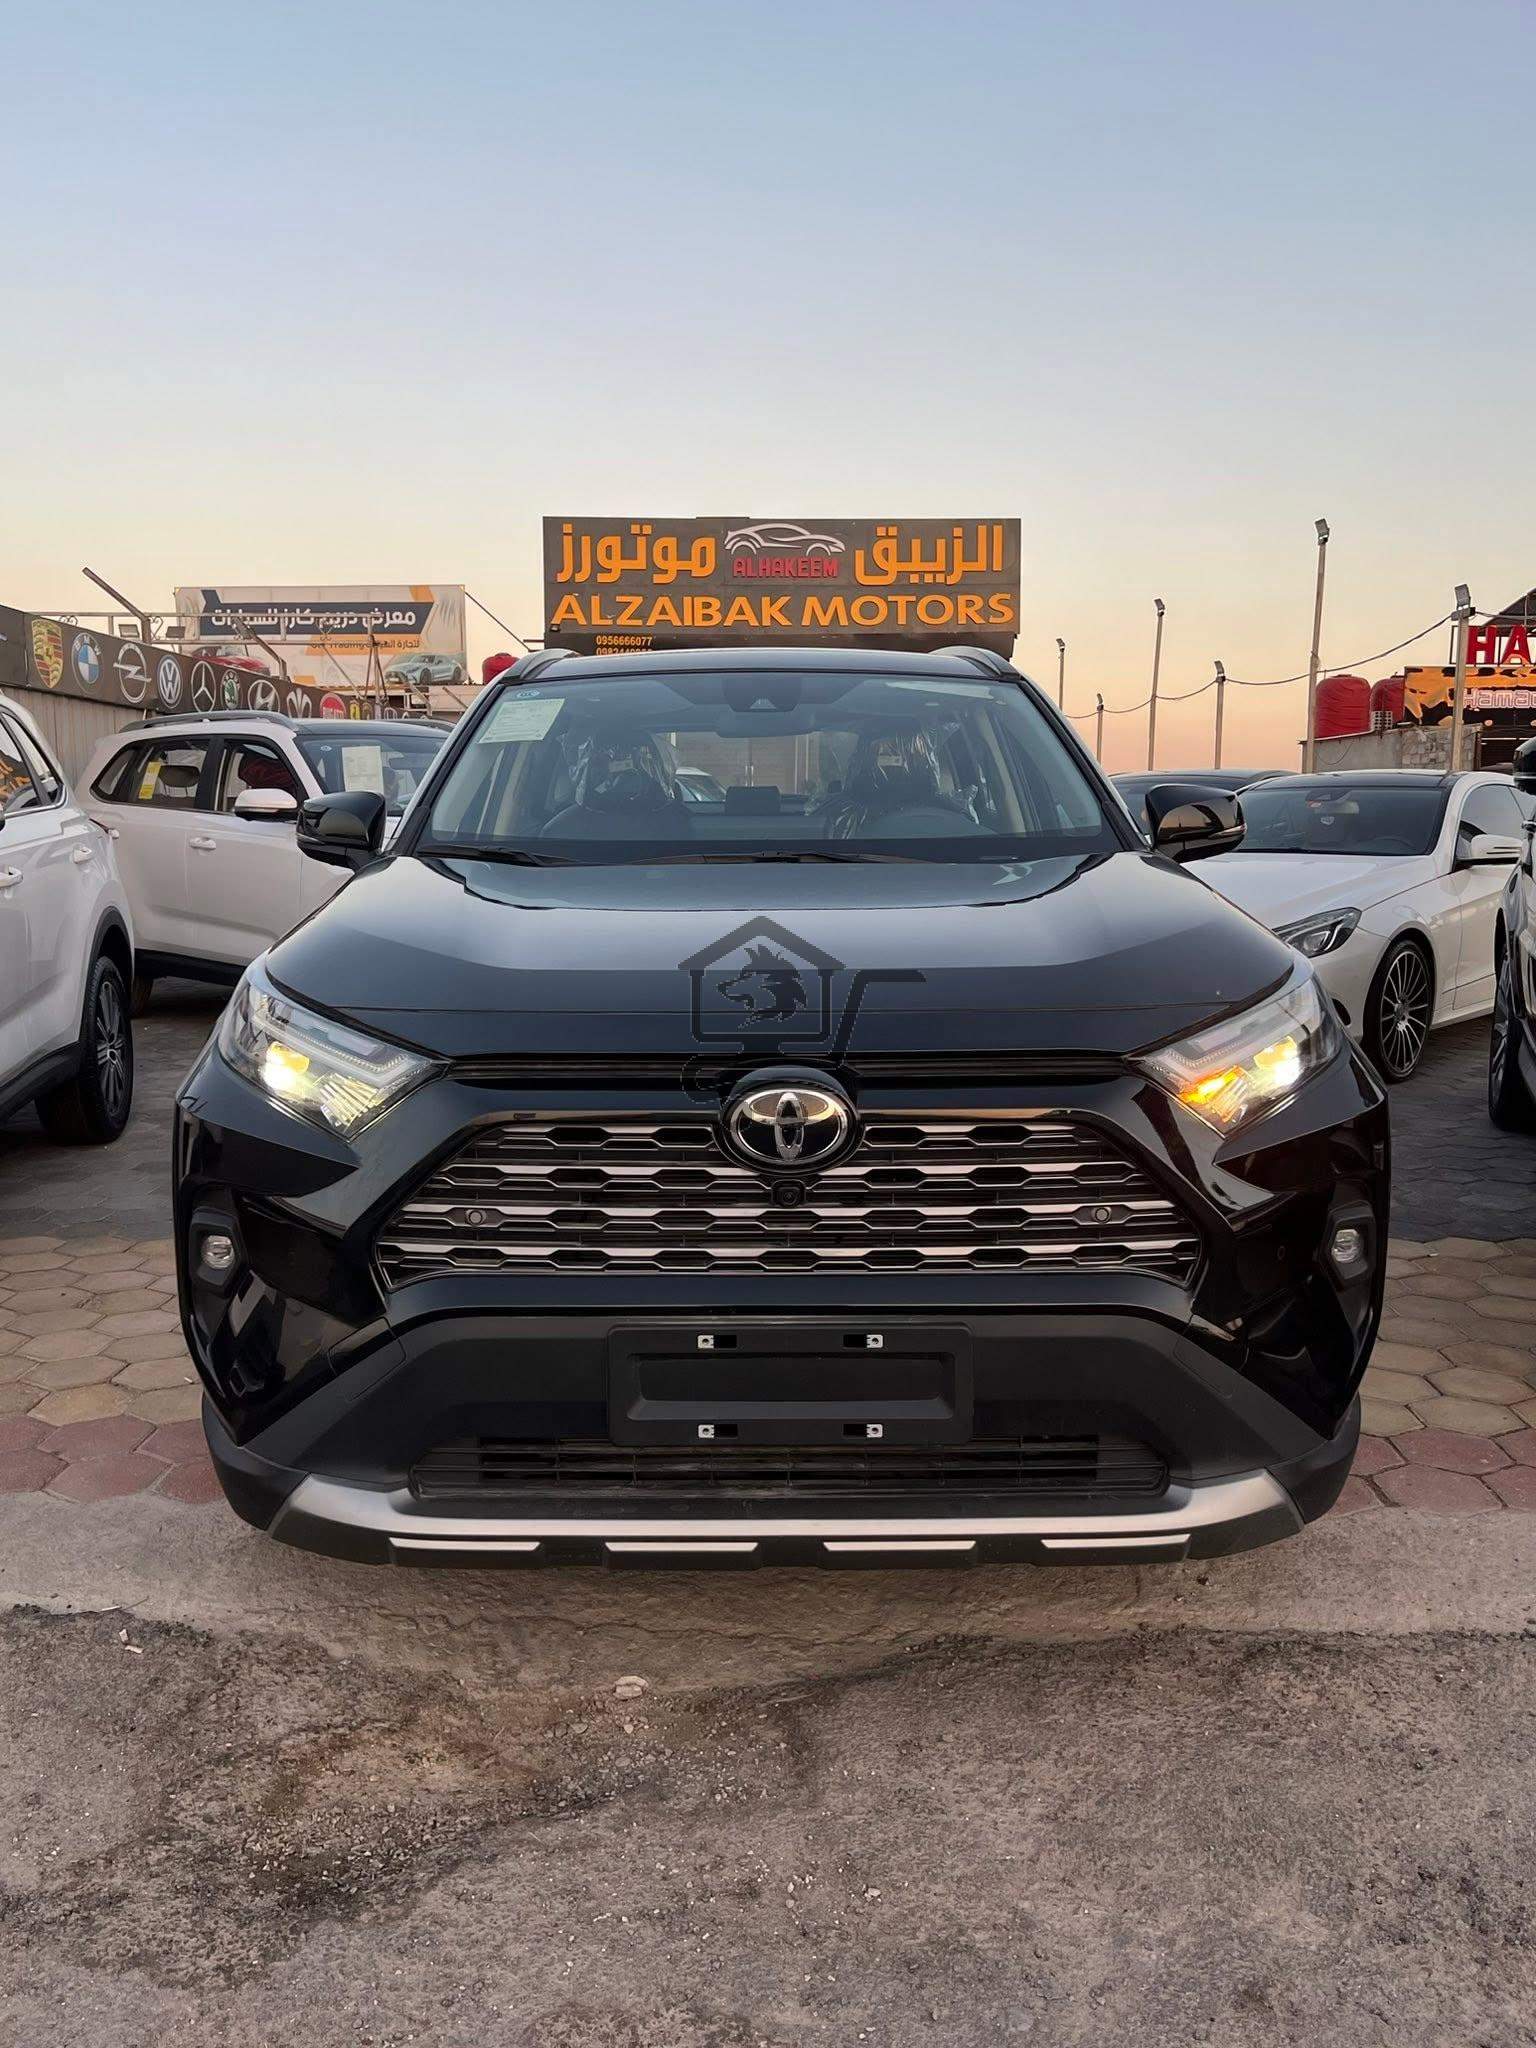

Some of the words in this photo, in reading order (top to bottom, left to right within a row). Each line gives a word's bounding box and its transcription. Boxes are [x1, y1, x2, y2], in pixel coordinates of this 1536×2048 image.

[557, 523, 716, 584] موتورز
[733, 557, 838, 577] ALHAKEEM
[855, 524, 1003, 585] الزيبق
[550, 594, 792, 627] ALZAIBAK
[801, 593, 1014, 627] MOTORS
